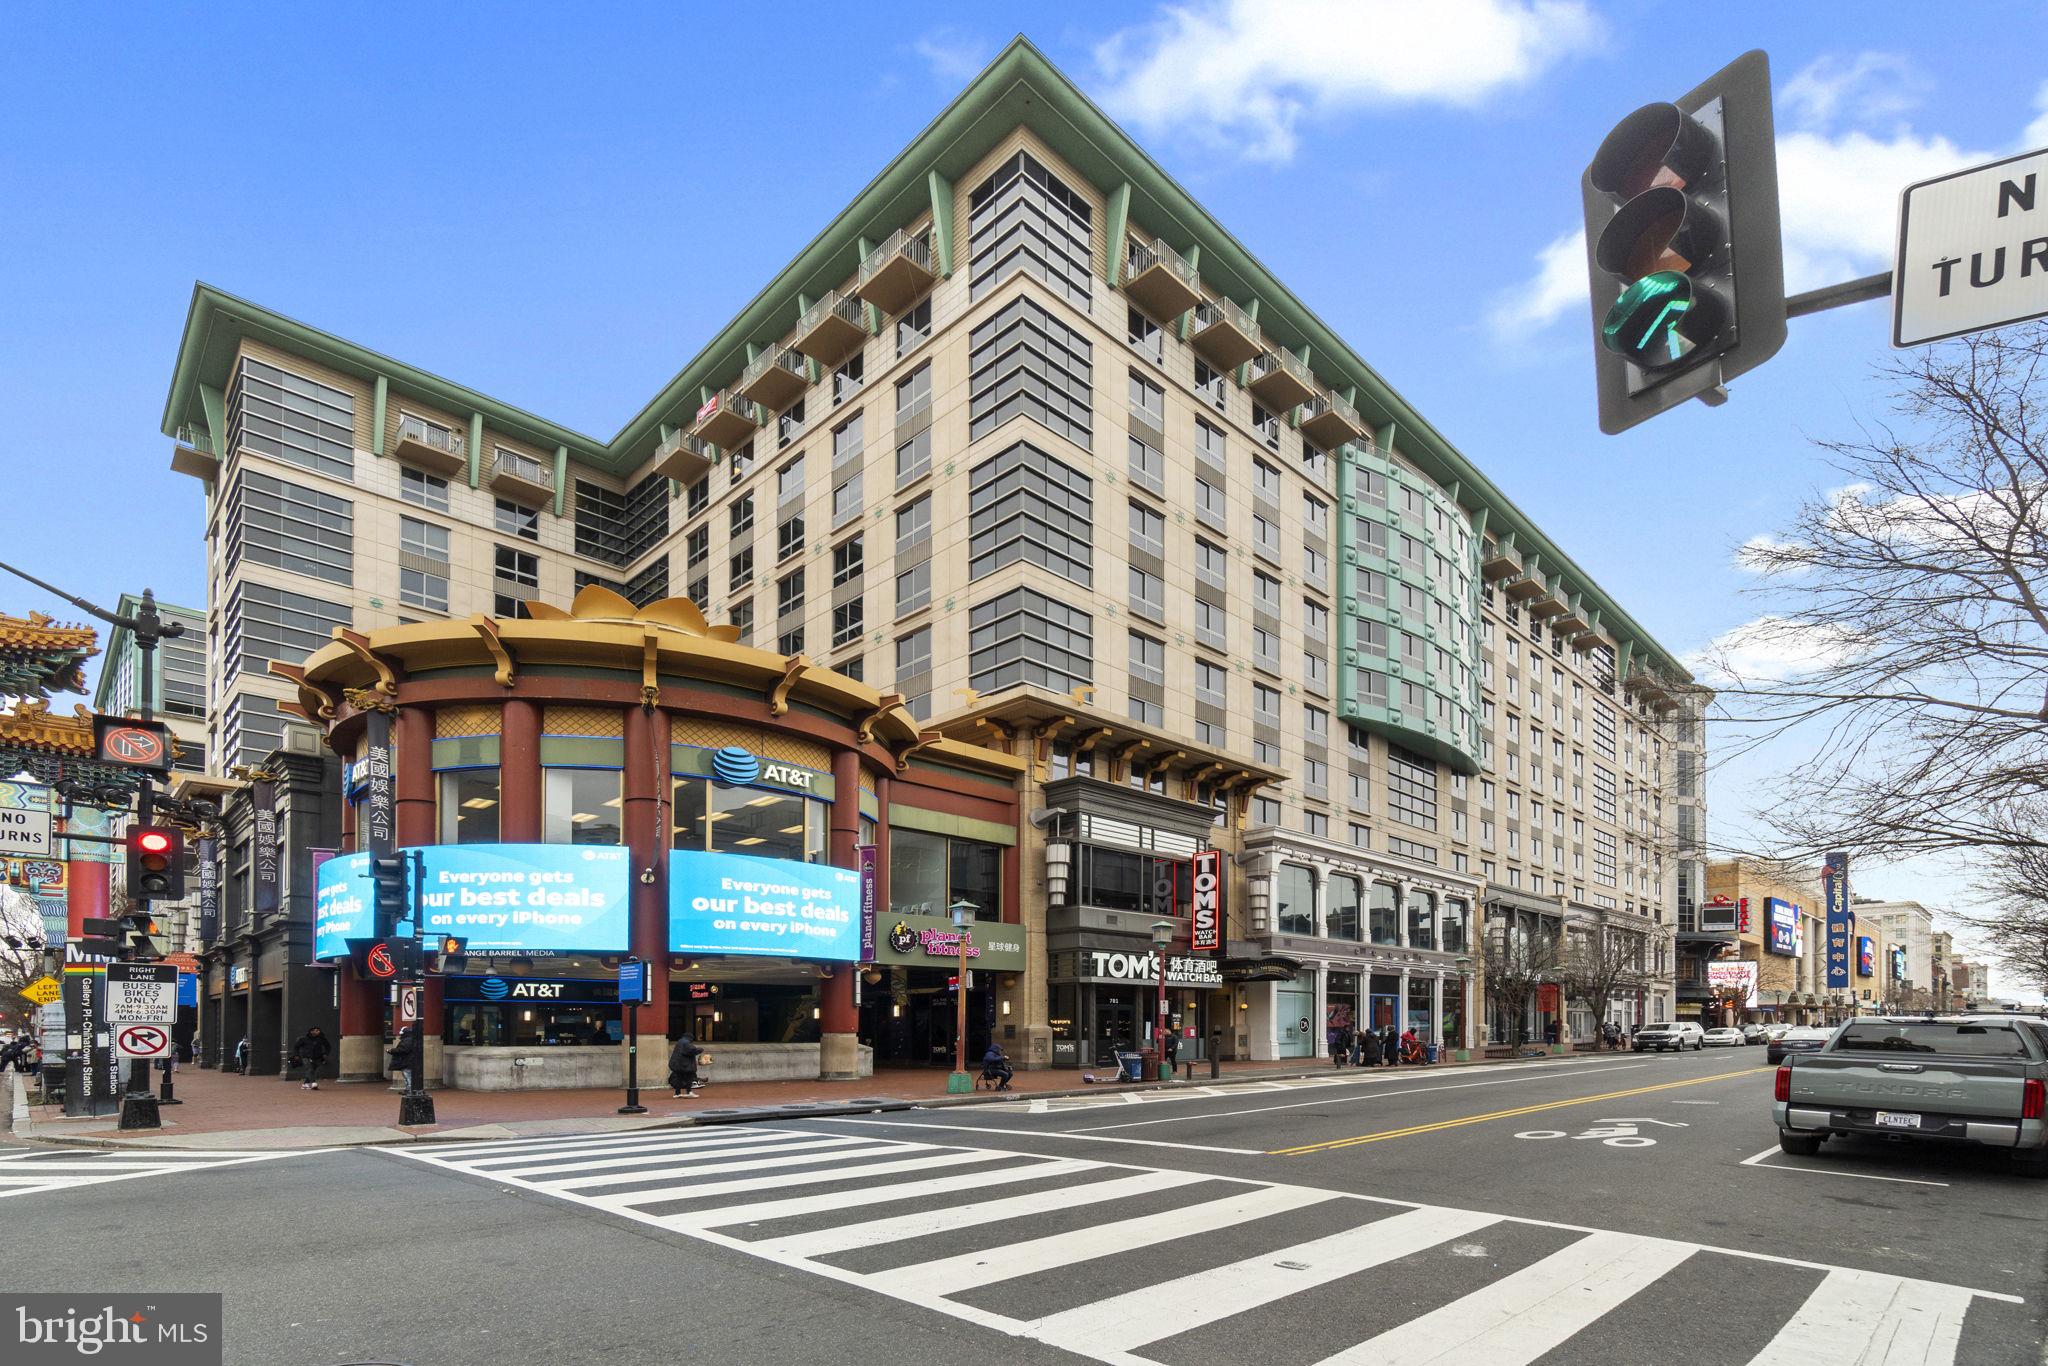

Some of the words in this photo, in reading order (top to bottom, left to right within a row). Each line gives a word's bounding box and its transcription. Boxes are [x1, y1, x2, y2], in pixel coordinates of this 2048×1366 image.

[352, 759, 369, 783] AT&
[763, 764, 814, 788] AT&T
[2, 812, 26, 824] NO
[439, 870, 525, 886] Everyone
[528, 870, 574, 886] gets
[720, 876, 800, 896] Everyone
[801, 887, 833, 900] gets
[460, 887, 521, 906] best
[527, 886, 606, 908] deals
[862, 878, 873, 913] fitness
[1194, 853, 1217, 929] TOMS
[330, 895, 363, 916] deals
[691, 896, 739, 913] our
[743, 895, 797, 918] best
[800, 901, 850, 923] deals
[430, 914, 452, 925] on
[455, 913, 510, 927] every
[713, 919, 737, 930] on
[739, 920, 788, 936] every
[789, 920, 837, 937] iPhone
[862, 915, 873, 949] planet
[898, 934, 912, 945] pf
[1091, 950, 1166, 980] TOM'S
[1170, 956, 1218, 974] 体育酒吧
[122, 982, 162, 990] BUSES
[1166, 971, 1202, 982] WATCH
[1203, 974, 1223, 983] BAR
[81, 977, 92, 1007] Gallery
[124, 989, 160, 997] BIKES
[512, 983, 565, 998] AT&T
[83, 1067, 93, 1096] Station
[110, 1066, 118, 1095] Station
[1836, 1080, 1968, 1099] TUNDRA
